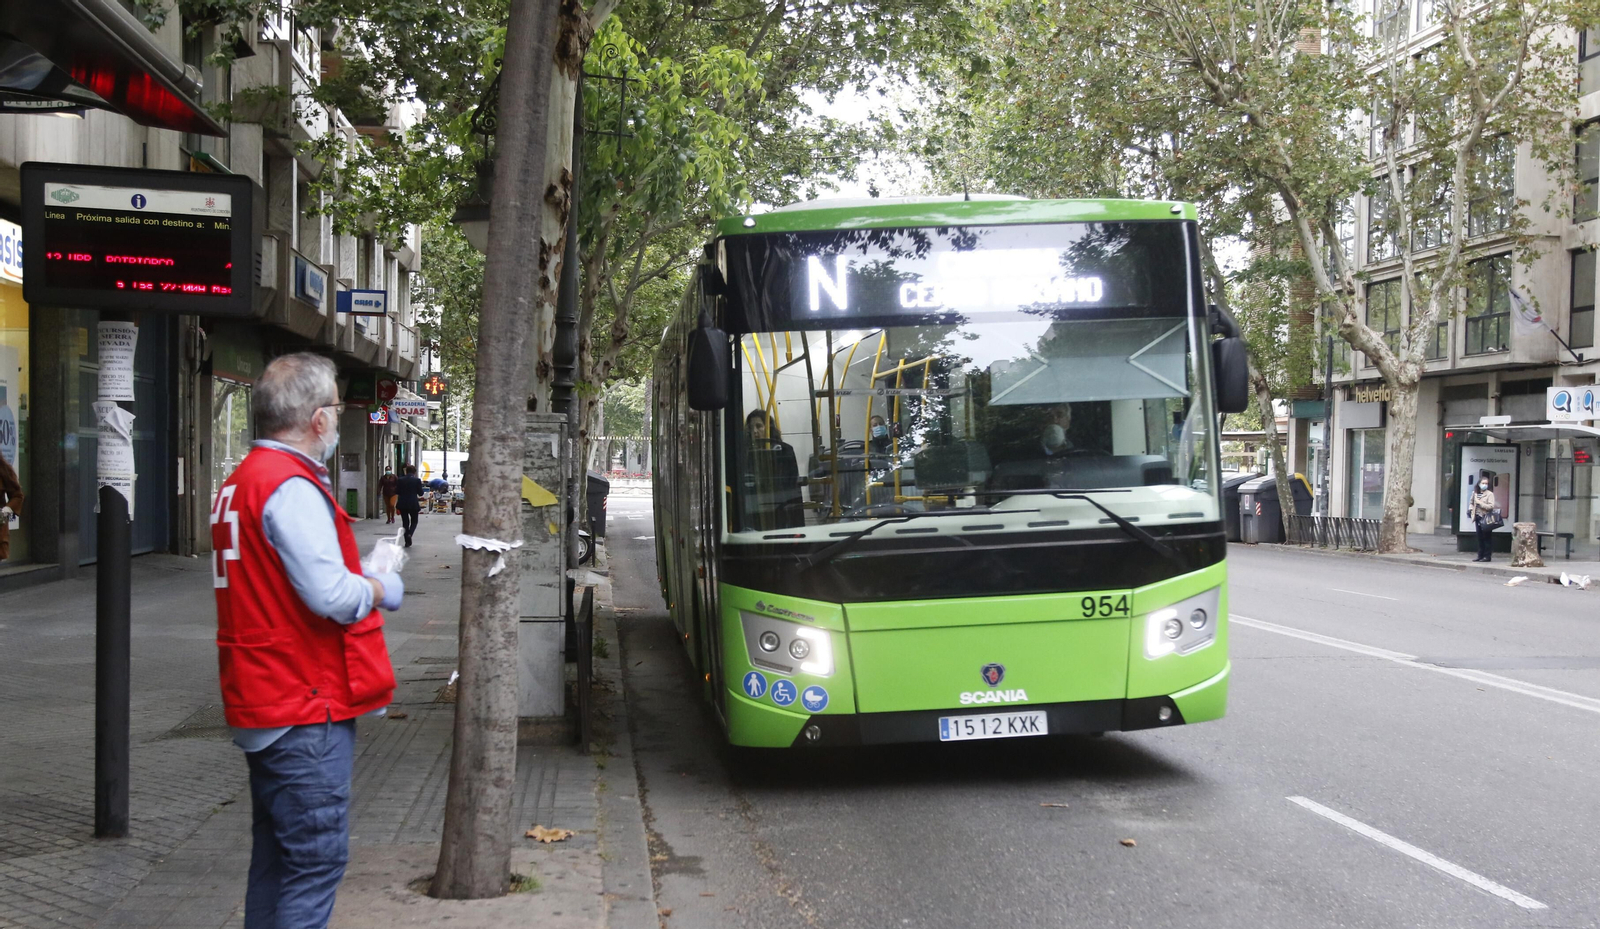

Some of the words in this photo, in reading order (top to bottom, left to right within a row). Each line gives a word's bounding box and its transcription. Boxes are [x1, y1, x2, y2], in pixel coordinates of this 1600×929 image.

[76, 212, 112, 223] Próxima
[115, 215, 140, 225] salida
[143, 218, 160, 226] con
[162, 218, 194, 229] destino
[196, 221, 205, 229] a:
[214, 221, 232, 231] Min.
[807, 254, 848, 311] N
[354, 299, 373, 307] asisa
[1355, 383, 1391, 403] helvetia
[1081, 594, 1130, 618] 954
[959, 689, 1029, 705] SCANIA
[953, 717, 1003, 737] 1512
[1007, 714, 1040, 734] KXK
